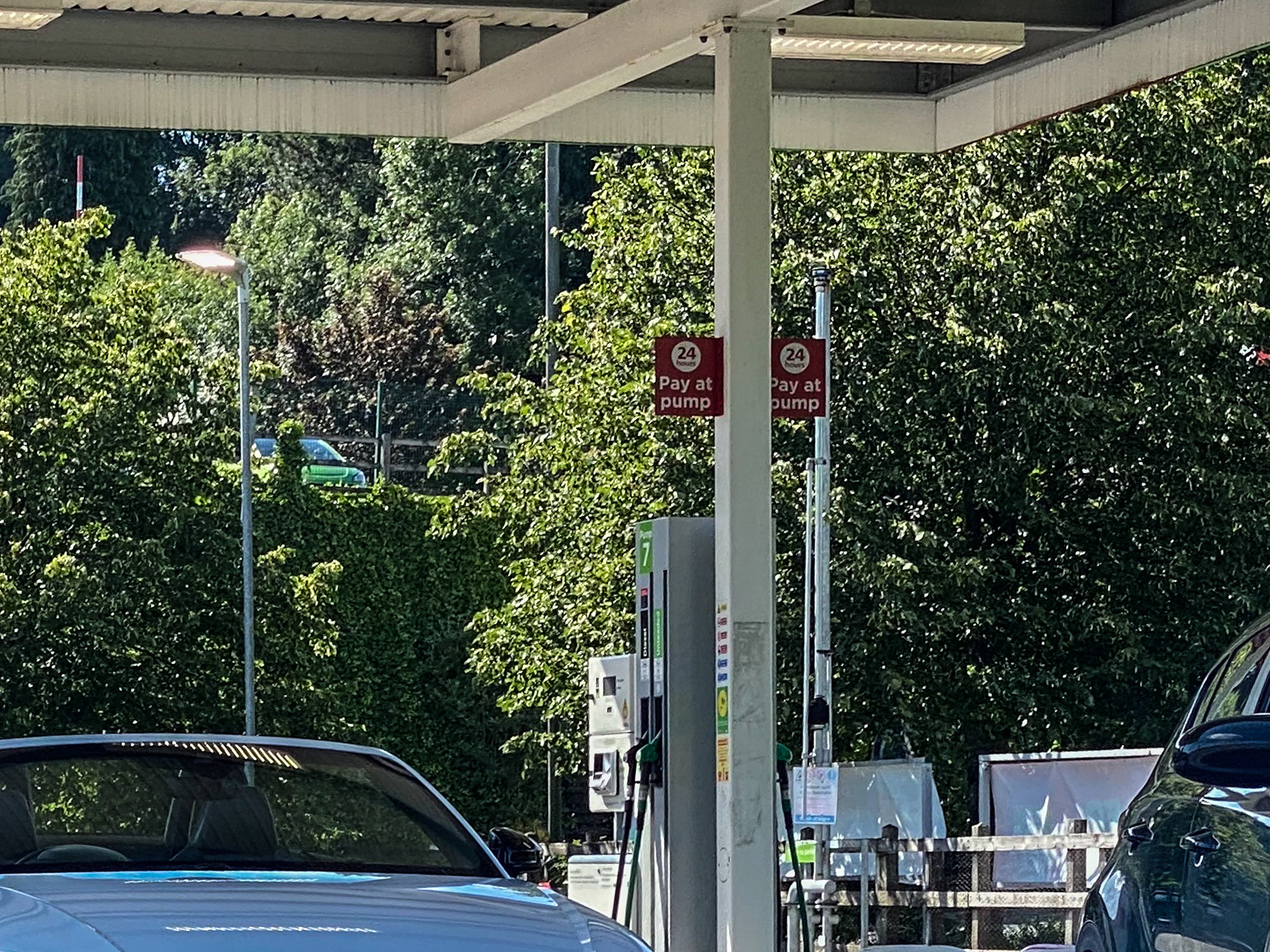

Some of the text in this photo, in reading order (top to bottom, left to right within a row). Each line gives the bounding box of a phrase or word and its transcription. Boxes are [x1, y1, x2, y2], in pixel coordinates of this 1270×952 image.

[677, 346, 697, 360] 24
[786, 348, 806, 362] 24
[659, 376, 713, 393] Pay at
[771, 378, 822, 395] Pay at
[660, 396, 711, 411] pump
[771, 398, 820, 413] pump
[642, 542, 650, 567] 7
